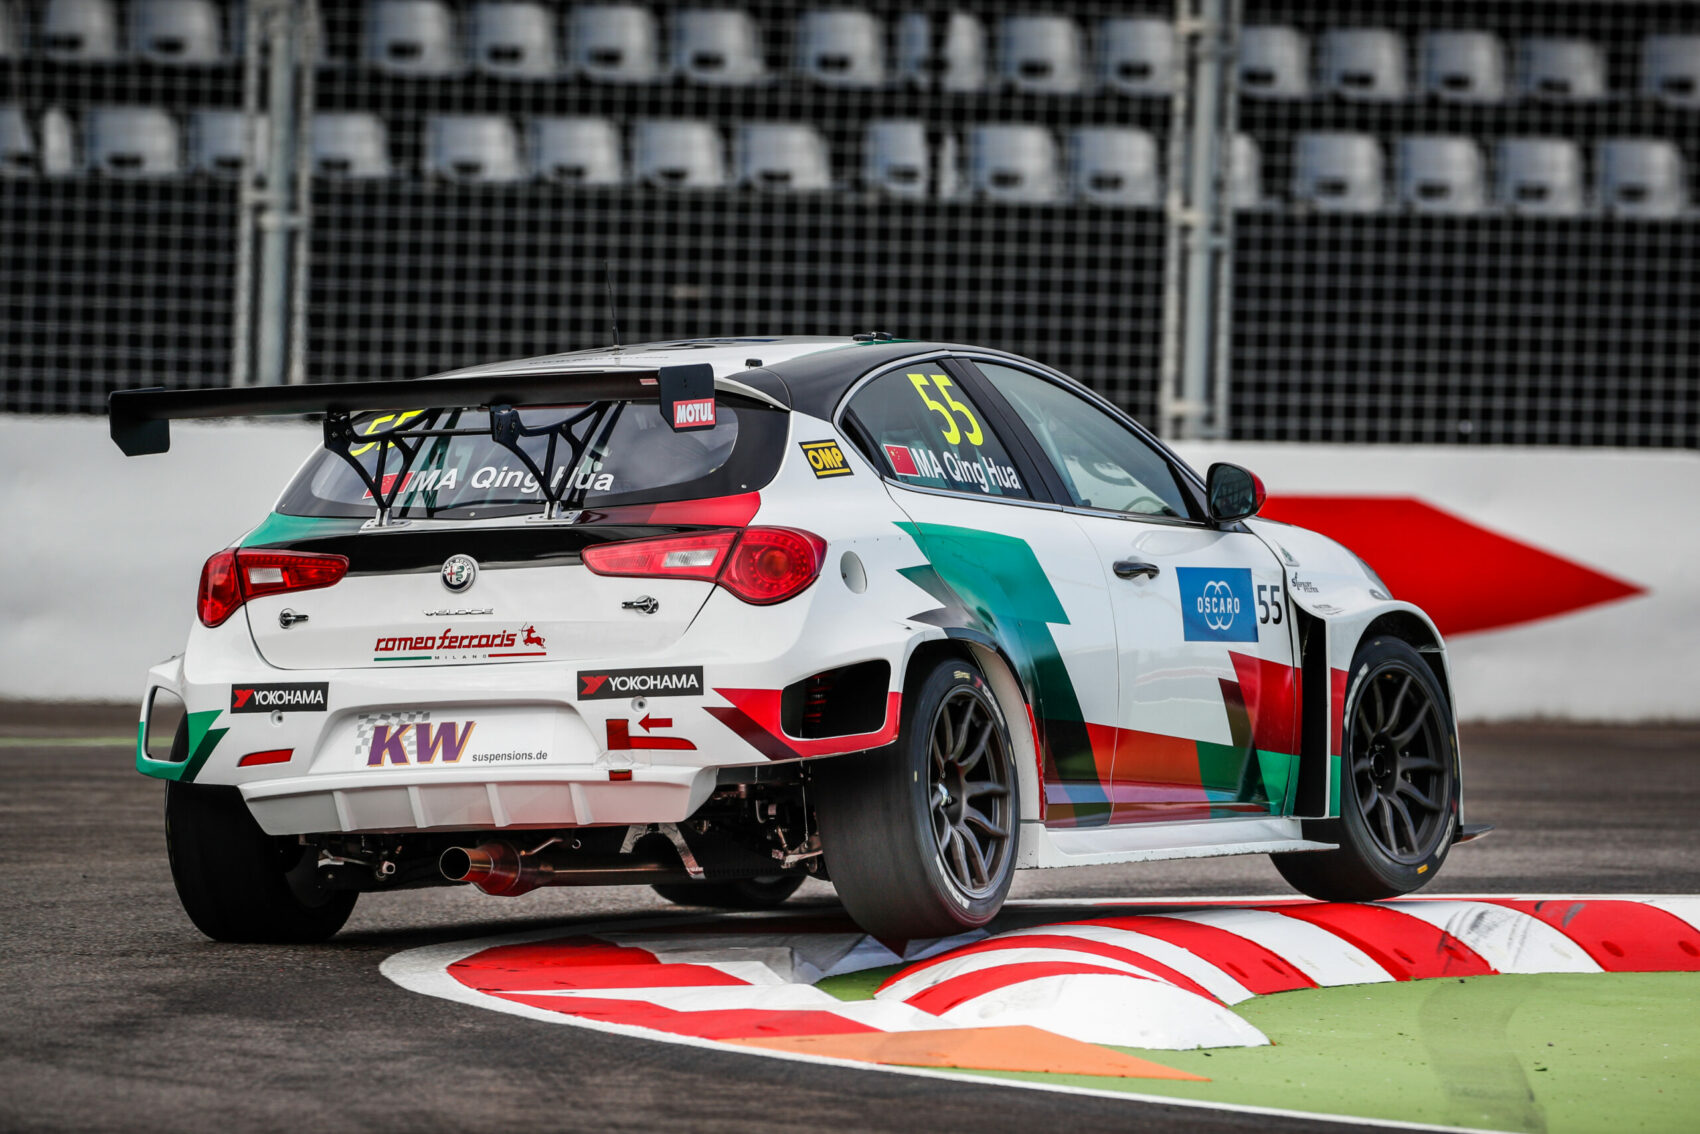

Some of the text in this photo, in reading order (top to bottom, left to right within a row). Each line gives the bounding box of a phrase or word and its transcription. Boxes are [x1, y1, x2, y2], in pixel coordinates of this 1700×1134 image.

[676, 402, 714, 424] MOTUL
[906, 373, 984, 446] 55
[807, 446, 843, 470] OMP
[409, 466, 615, 493] MA Qing Hua
[910, 448, 1022, 493] MA Qing Hua
[423, 608, 494, 617] VELOCE
[1197, 596, 1240, 614] OSCARO
[1257, 585, 1283, 625] 55
[374, 628, 518, 652] romeo ferraris
[607, 673, 700, 692] YOKOHAMA
[253, 689, 325, 706] YOKOHAMA
[366, 720, 477, 768] KW
[472, 750, 548, 764] suspensions.de
